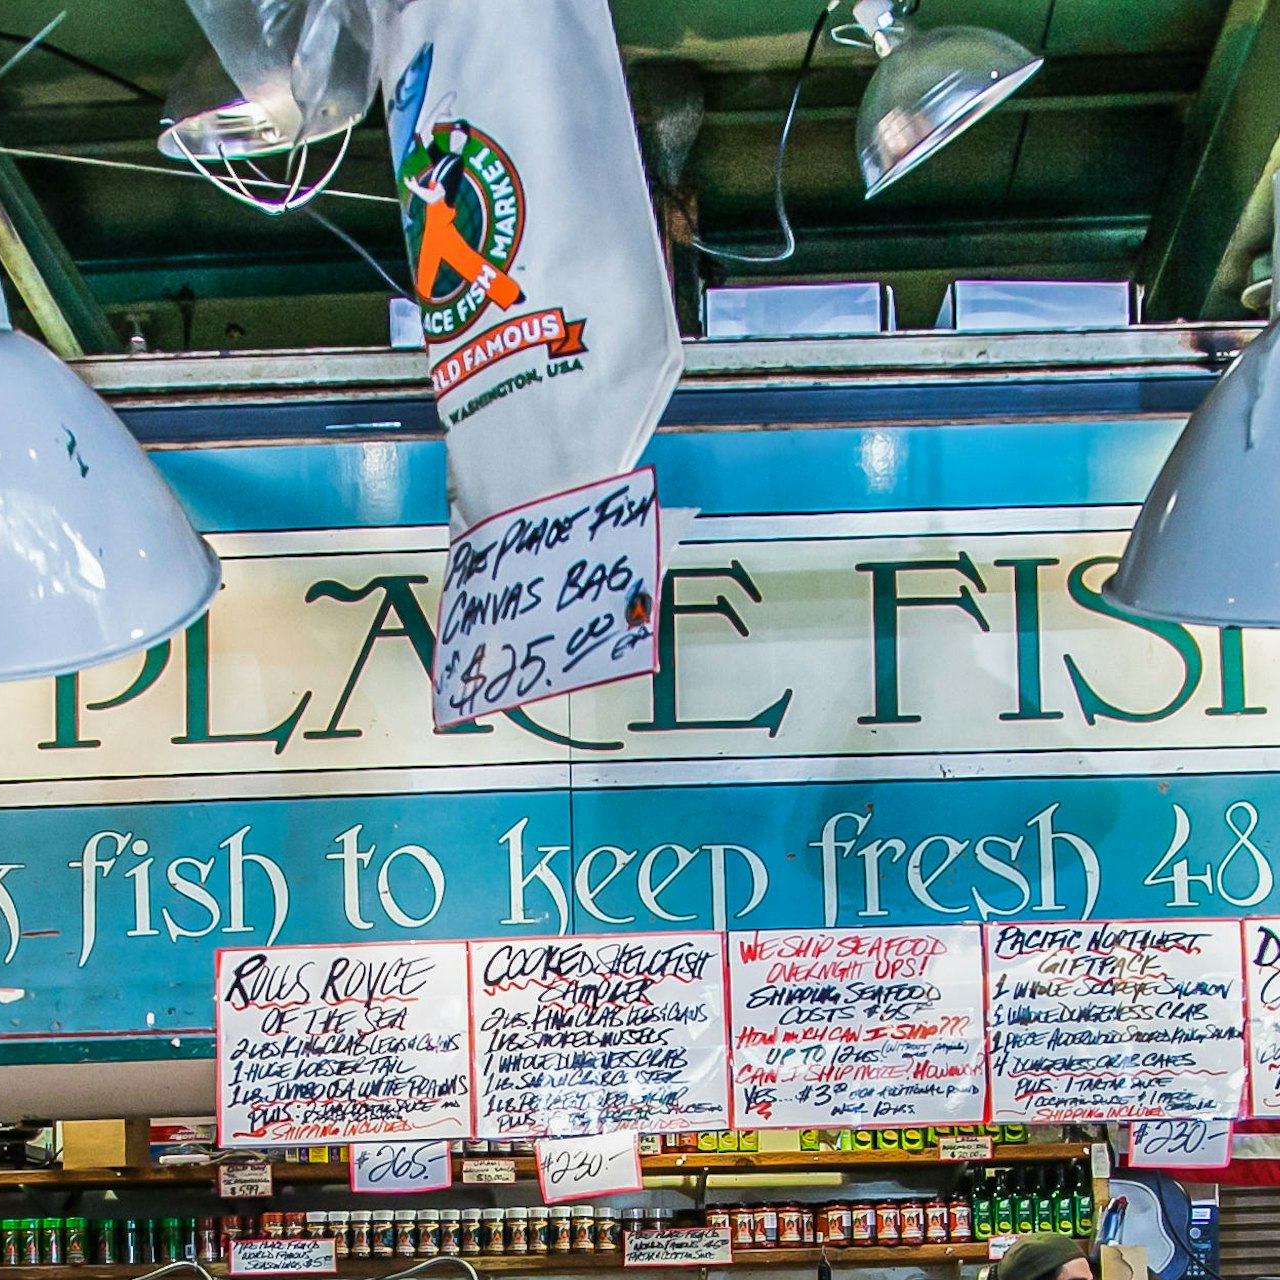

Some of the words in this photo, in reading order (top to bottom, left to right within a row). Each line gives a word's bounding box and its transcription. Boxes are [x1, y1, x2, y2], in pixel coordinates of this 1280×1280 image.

[470, 148, 516, 259] MARKET
[470, 312, 559, 373] FAMOUS
[442, 574, 542, 644] CANVAS
[37, 560, 792, 750] PLAE
[68, 826, 290, 967] fish
[326, 824, 446, 931] to
[498, 817, 769, 936] keep
[810, 803, 1102, 928] fresh
[1143, 802, 1276, 908] 48
[483, 942, 593, 986] COOKED
[739, 931, 773, 964] WE
[776, 934, 833, 959] SHIP
[837, 934, 948, 958] SEAFOOD
[995, 927, 1082, 950] PACIFIC
[224, 953, 315, 1007] ROLLS
[320, 956, 436, 1008] ROYCE
[845, 981, 941, 1004] SEAFOOD
[779, 1005, 854, 1025] COSTS
